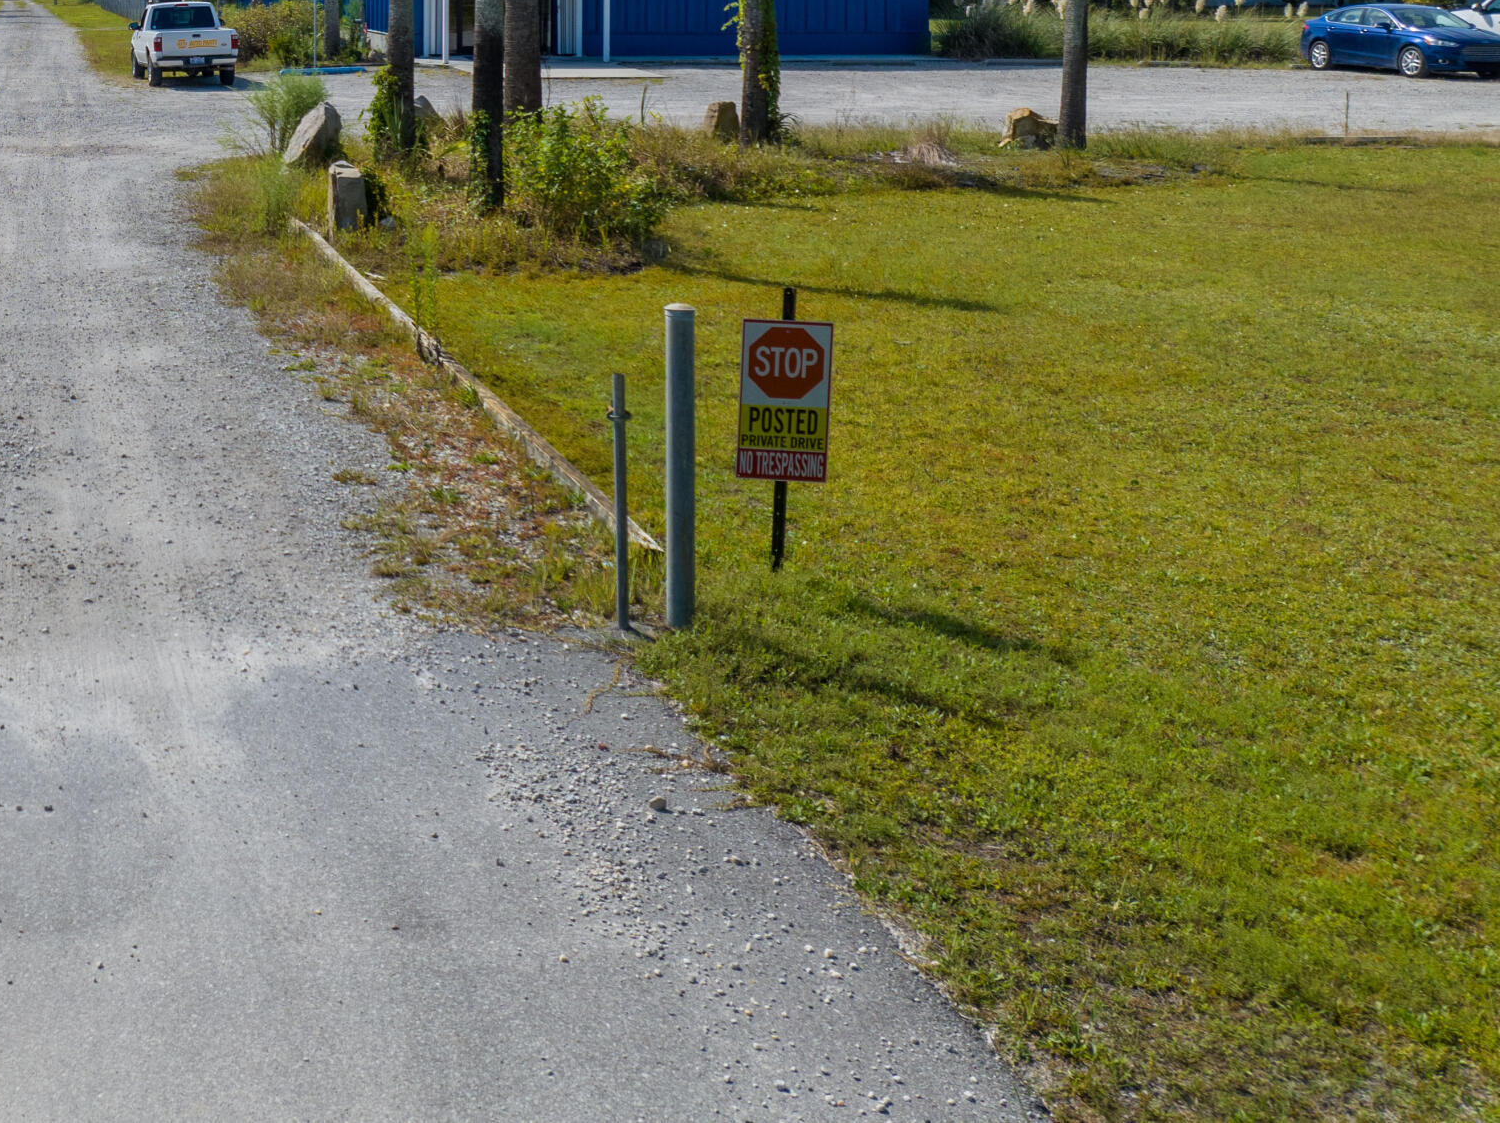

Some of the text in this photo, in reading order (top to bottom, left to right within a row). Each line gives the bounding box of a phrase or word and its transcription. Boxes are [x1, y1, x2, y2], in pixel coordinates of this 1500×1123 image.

[754, 346, 819, 379] STOP
[748, 407, 819, 435] POSTED
[741, 434, 824, 450] PRIVATE DRIVE
[739, 451, 824, 478] NO TRESPASSING
